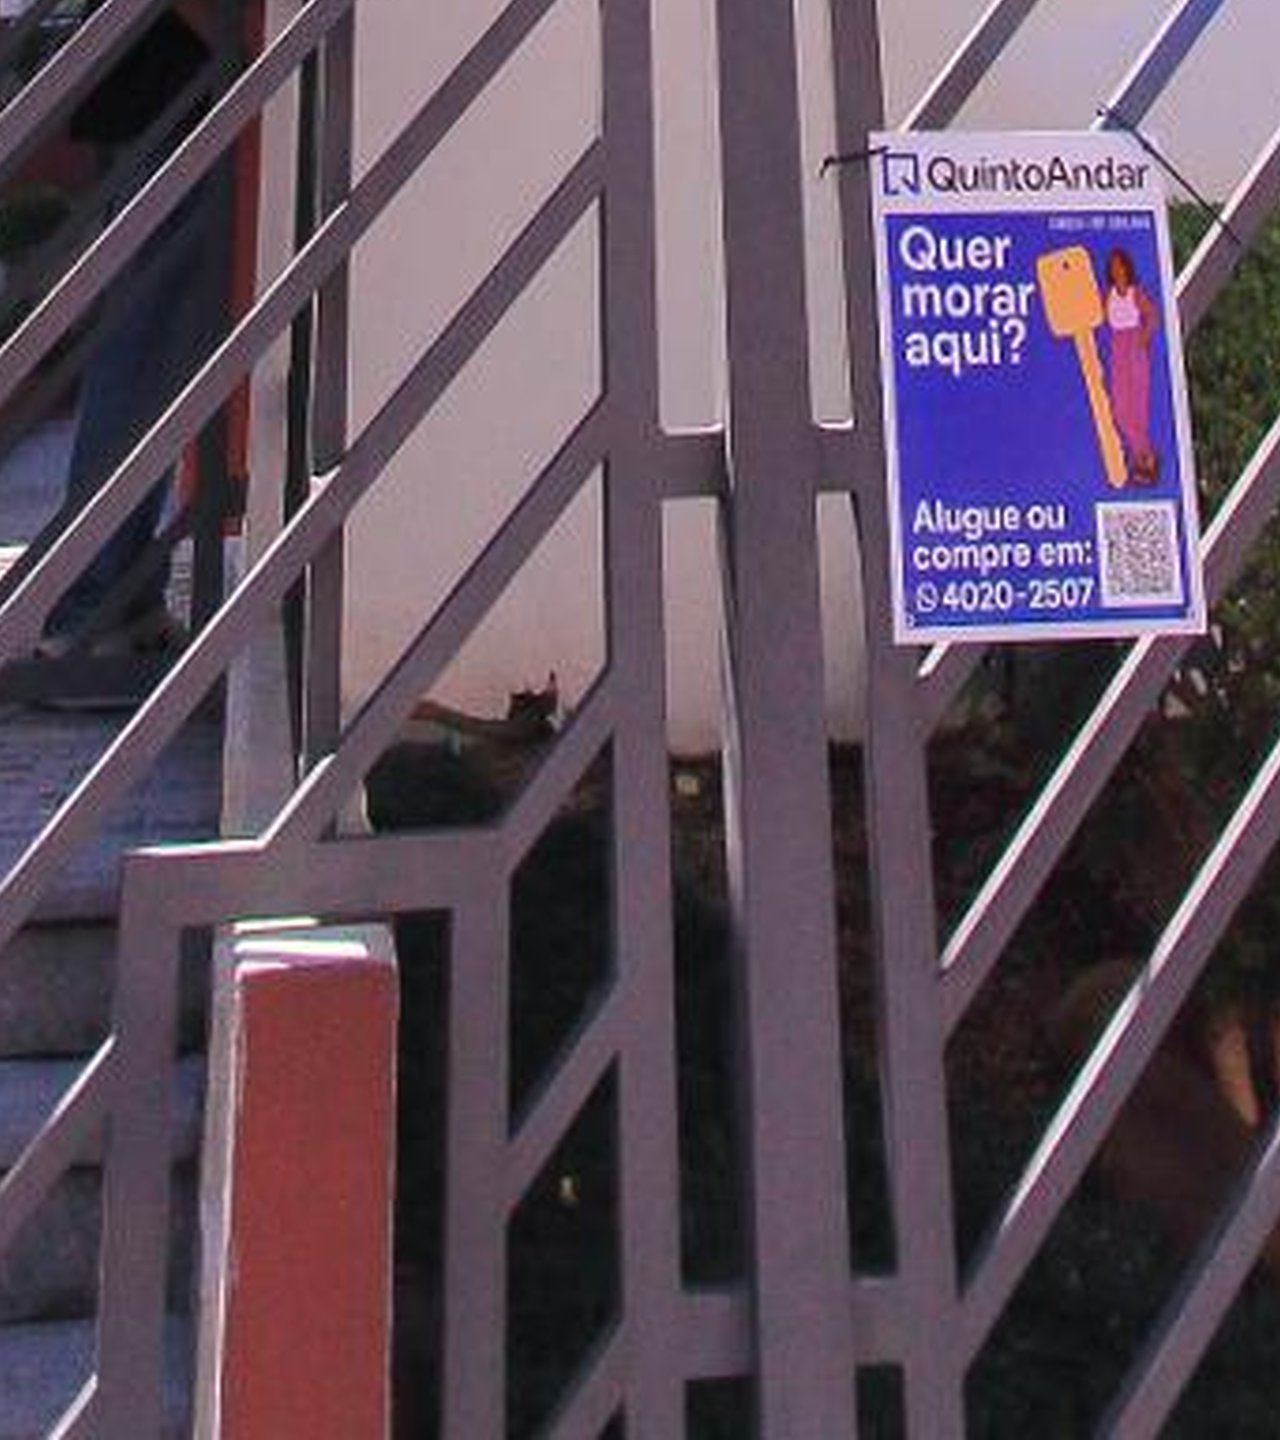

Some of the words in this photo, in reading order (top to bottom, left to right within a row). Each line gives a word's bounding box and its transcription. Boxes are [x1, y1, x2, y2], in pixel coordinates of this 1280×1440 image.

[927, 156, 1149, 194] QuintoAndar
[899, 226, 1012, 272] Quer
[902, 281, 1035, 317] morar
[904, 318, 1027, 377] aqui?
[913, 498, 1020, 540] Alugue
[1027, 505, 1066, 531] ou
[913, 543, 1031, 576] compre
[1038, 541, 1093, 566] em:
[943, 578, 1095, 611] 4020-2507
